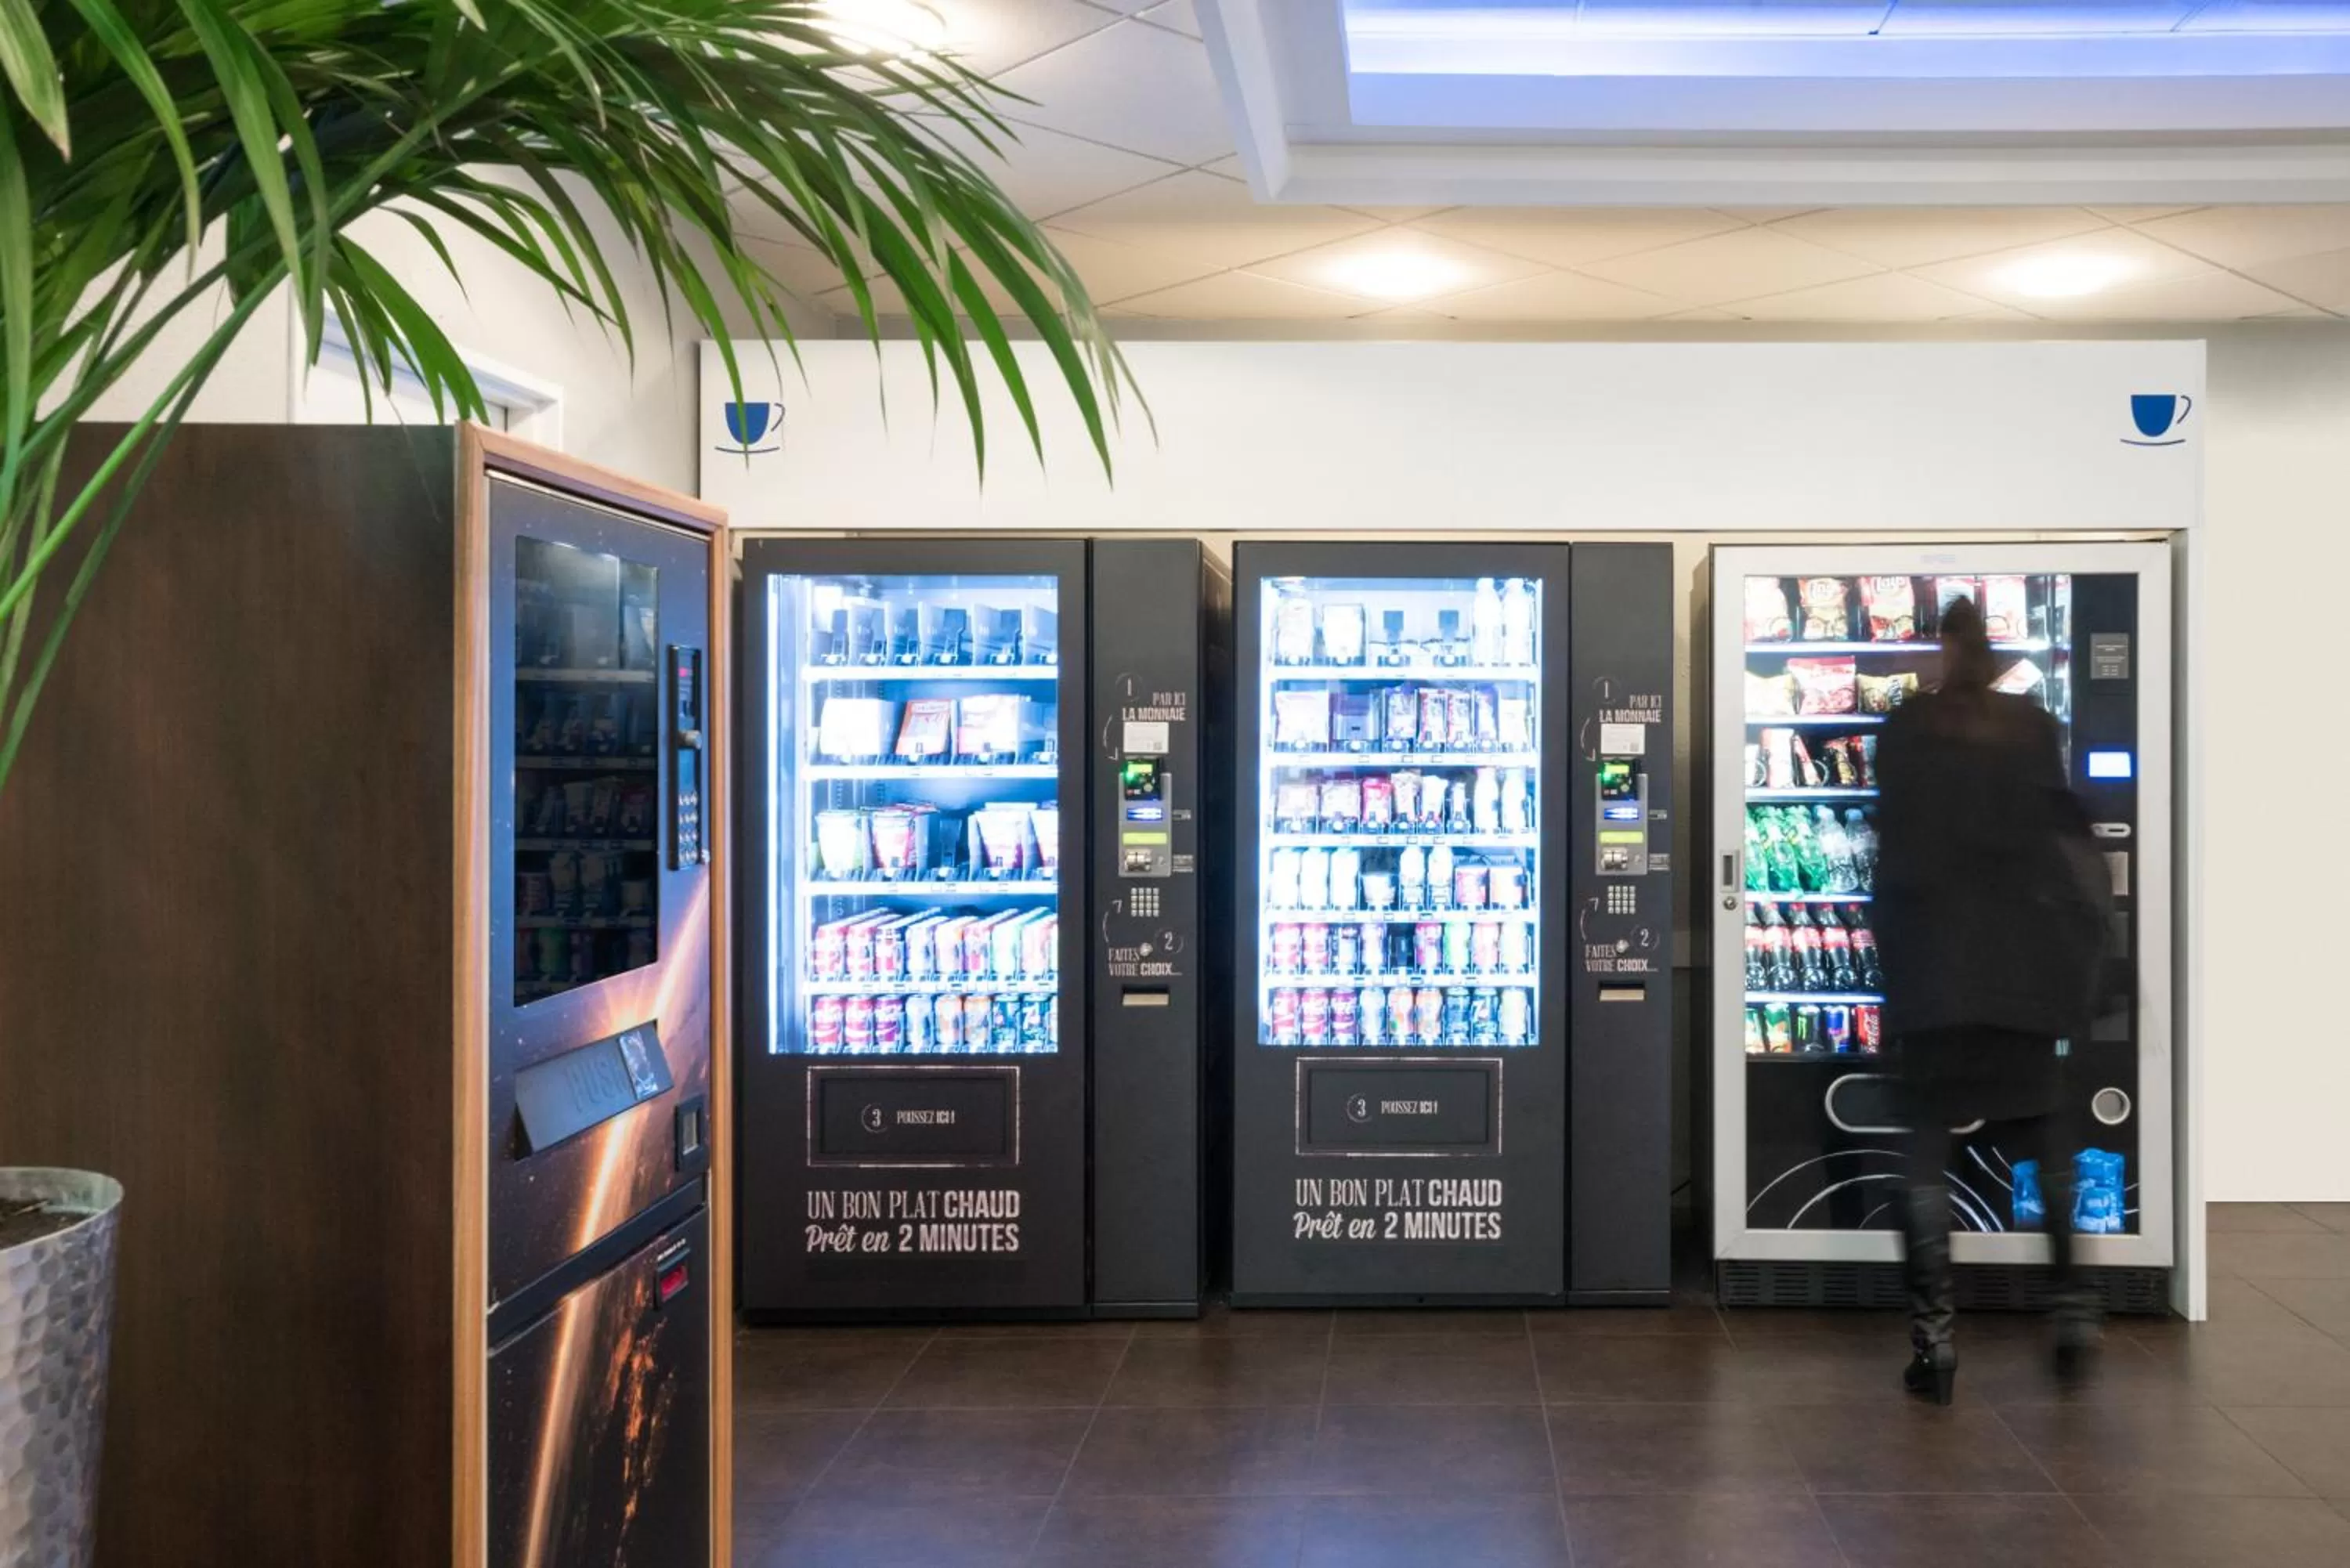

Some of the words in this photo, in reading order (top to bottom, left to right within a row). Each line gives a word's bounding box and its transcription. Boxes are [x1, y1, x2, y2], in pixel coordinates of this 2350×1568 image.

[1122, 707, 1136, 721] LA
[1137, 707, 1186, 721] MONNAIE
[1599, 709, 1613, 723] LA
[1614, 709, 1661, 723] MONNAIE
[1164, 931, 1173, 950] 2
[1640, 928, 1649, 947] 2
[1108, 963, 1138, 977] VOTRE
[1585, 959, 1614, 973] VOTRE
[1358, 1098, 1366, 1117] 3
[1380, 1100, 1419, 1115] POUSSEZ
[872, 1108, 881, 1127] 3
[896, 1109, 935, 1125] POUSSEZ
[1295, 1179, 1323, 1207] UN
[1329, 1179, 1368, 1207] BON
[1374, 1179, 1425, 1208] PLAT
[1427, 1179, 1502, 1207] CHAUD
[807, 1190, 835, 1219] UN
[842, 1190, 882, 1219] BON
[888, 1190, 941, 1219] PLAT
[943, 1190, 1021, 1219] CHAUD
[1292, 1211, 1344, 1240] Prêt
[1347, 1217, 1376, 1240] en
[1384, 1212, 1398, 1240] 2
[1404, 1212, 1502, 1240] MINUTES
[804, 1223, 857, 1253] Prêt
[862, 1230, 891, 1253] en
[898, 1224, 913, 1252] 2
[919, 1223, 1020, 1253] MINUTES
